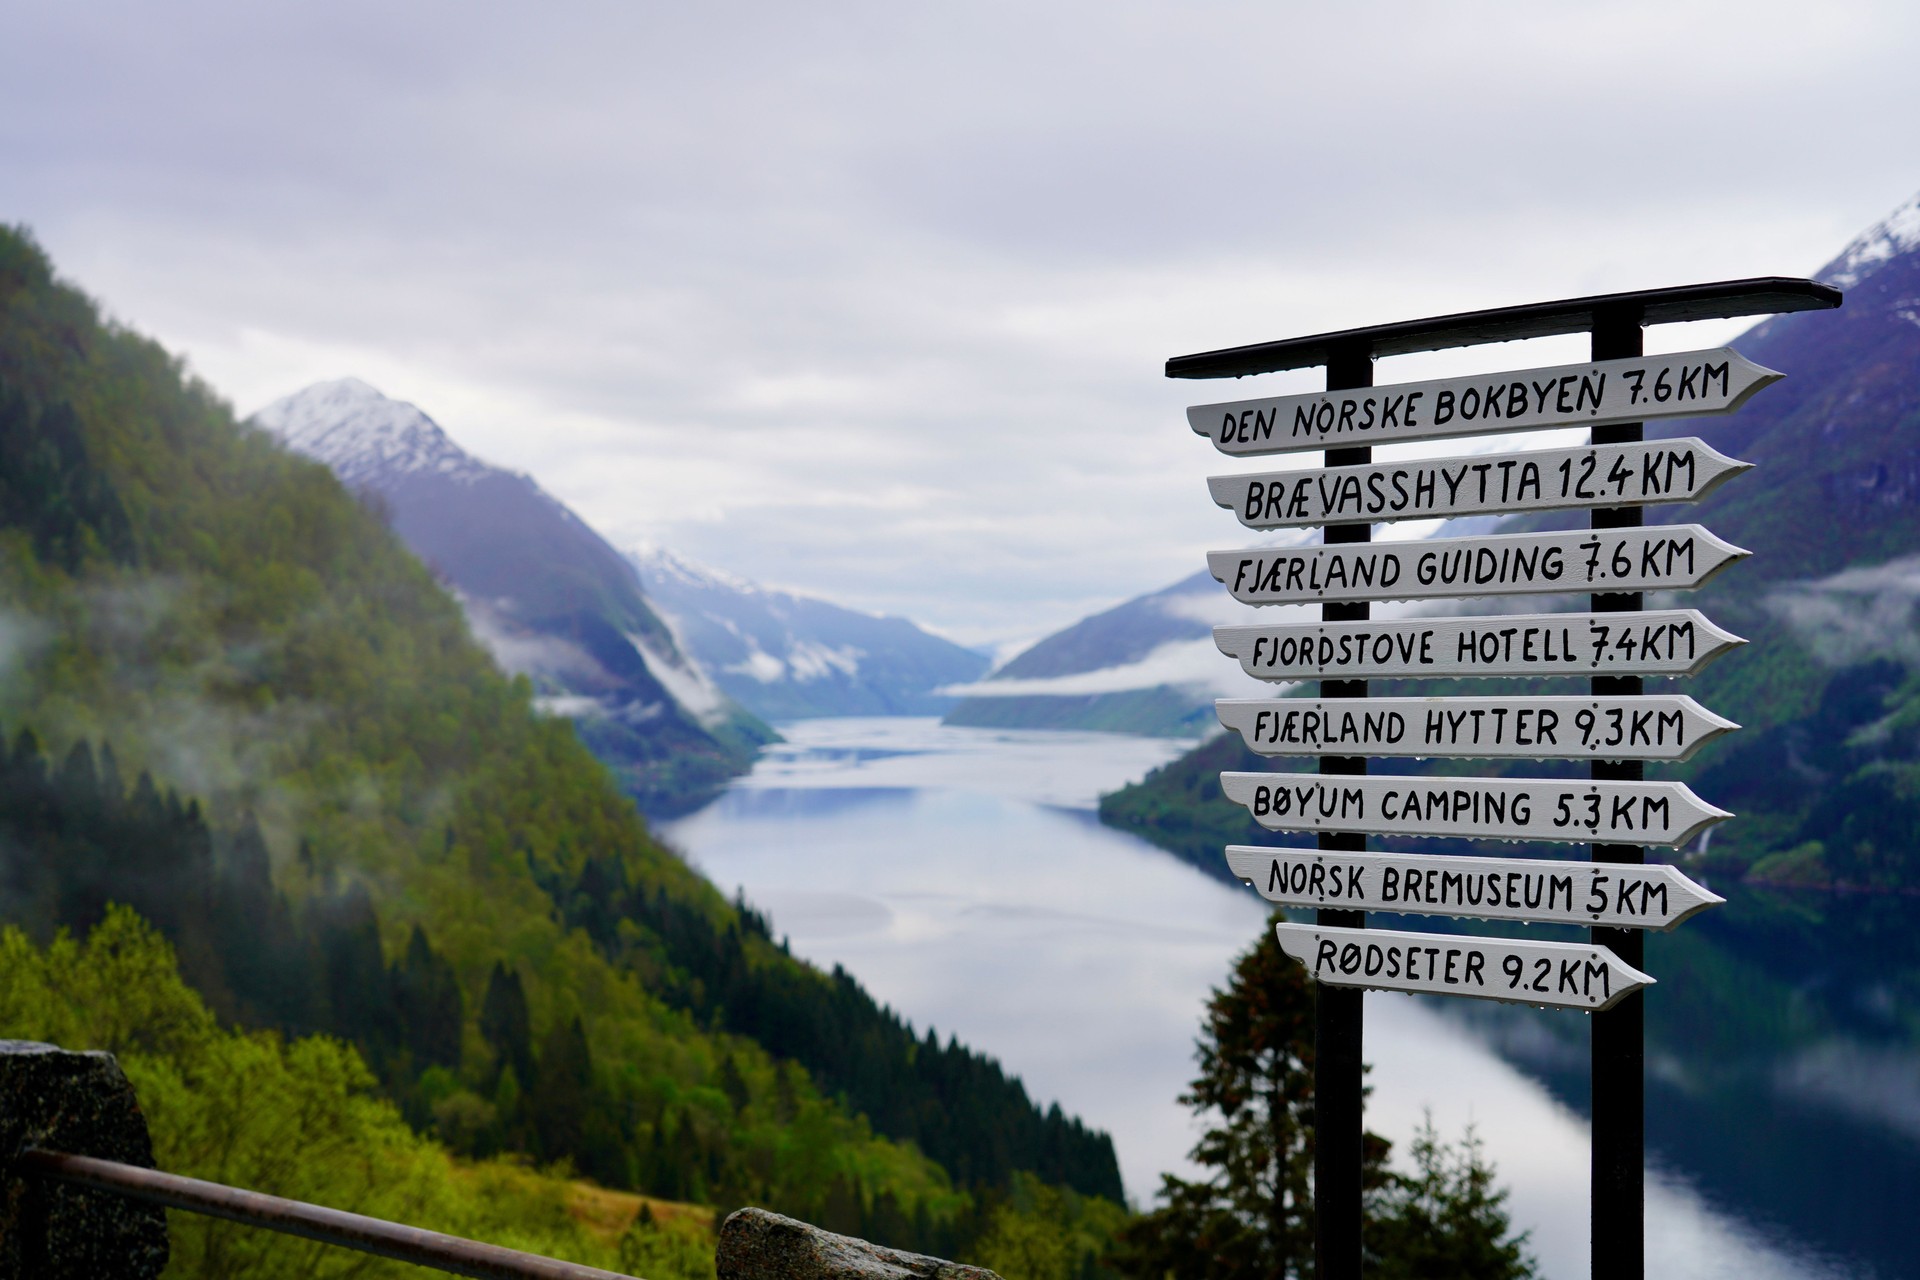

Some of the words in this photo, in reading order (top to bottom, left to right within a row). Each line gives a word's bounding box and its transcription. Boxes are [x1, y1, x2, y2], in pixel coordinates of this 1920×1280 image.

[1219, 406, 1277, 444] DEN
[1291, 392, 1424, 438] NORSKE
[1433, 373, 1607, 426] BOKBYEN
[1244, 461, 1542, 521] BRÆVASSHYTTA
[1233, 553, 1401, 593] FJÆRLAND
[1416, 546, 1564, 586] GUIDING
[1253, 630, 1434, 668] FJORDSTOVE
[1457, 628, 1578, 665] HOTELL
[1254, 710, 1405, 745] FJÆRLAND
[1424, 708, 1559, 745] HYTTER
[1253, 785, 1364, 820] BØYUM
[1381, 790, 1531, 826] CAMPING
[1268, 858, 1365, 902] NORSK
[1381, 866, 1573, 914] BREMUSEUM
[1315, 938, 1486, 987] RØDSETER
